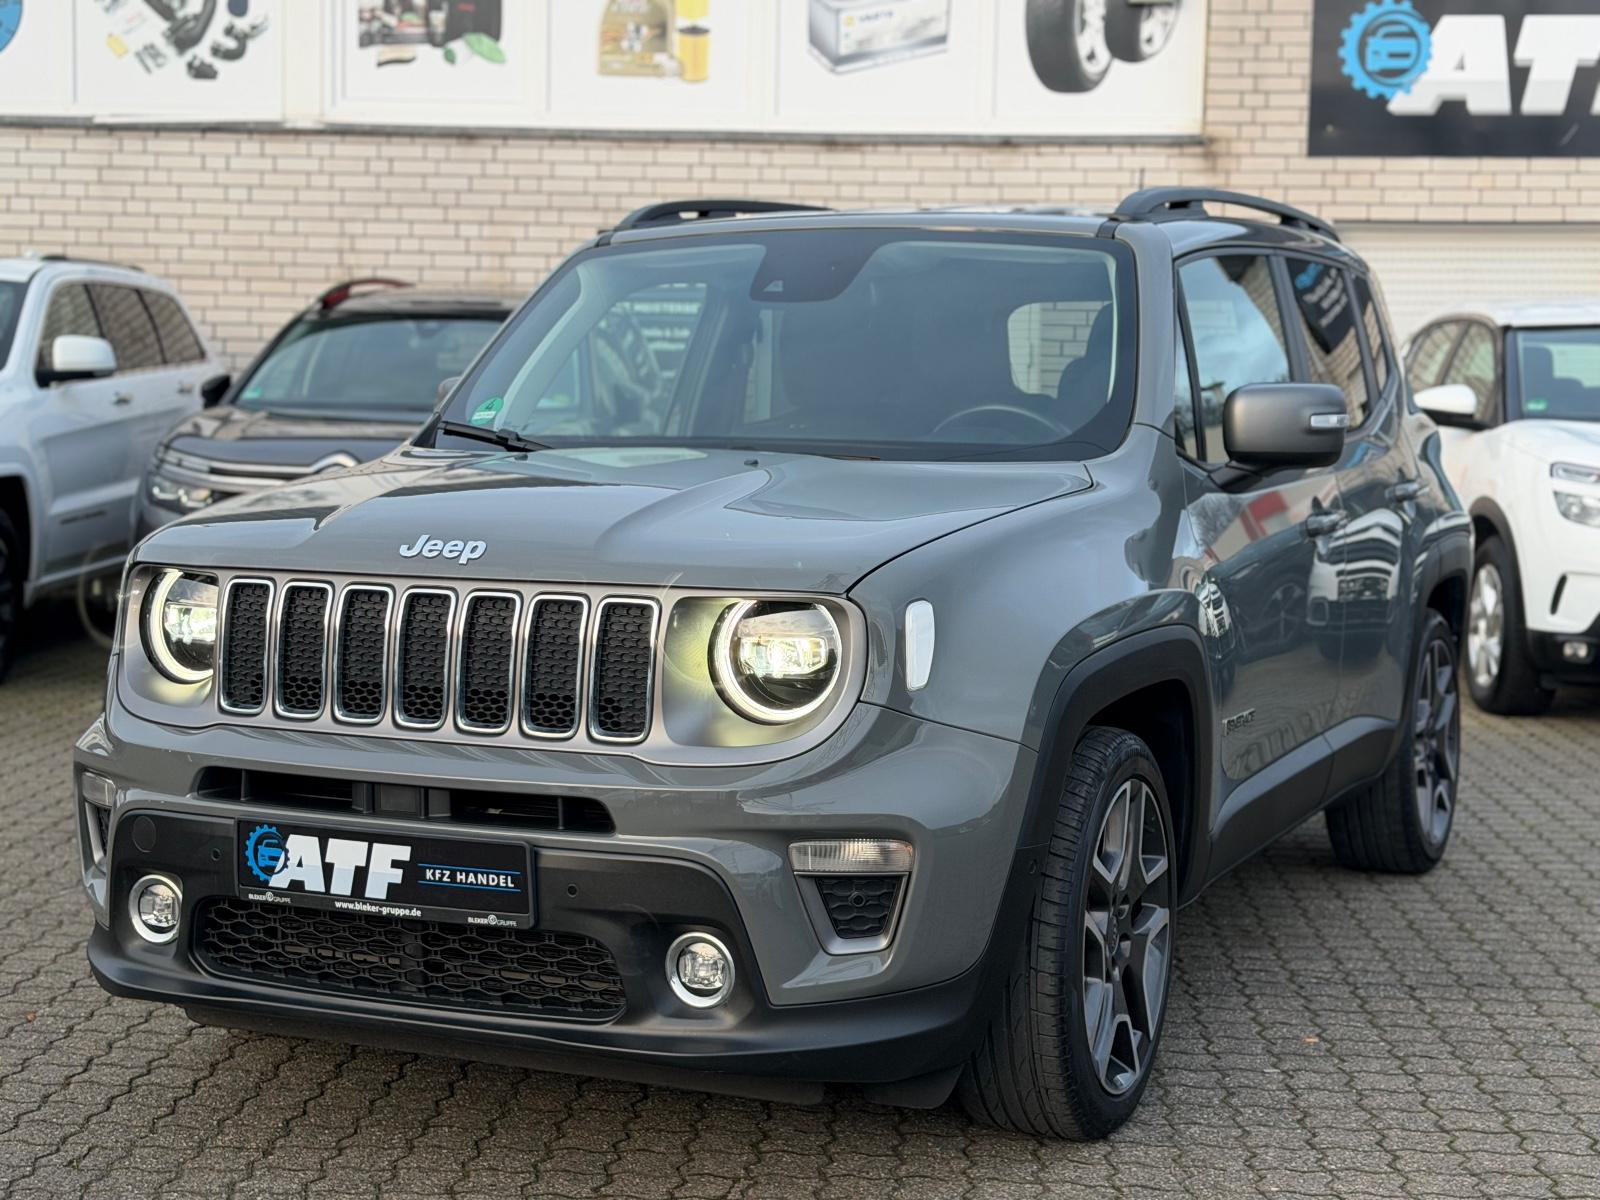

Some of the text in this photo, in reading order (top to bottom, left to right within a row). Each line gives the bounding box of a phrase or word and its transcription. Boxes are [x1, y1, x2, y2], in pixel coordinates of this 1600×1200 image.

[1386, 14, 1600, 116] AT
[399, 534, 487, 566] Jeep
[268, 833, 412, 900] ATF
[425, 868, 515, 888] KFZ HANDEL
[334, 900, 422, 917] www.bleker-gruppe.de
